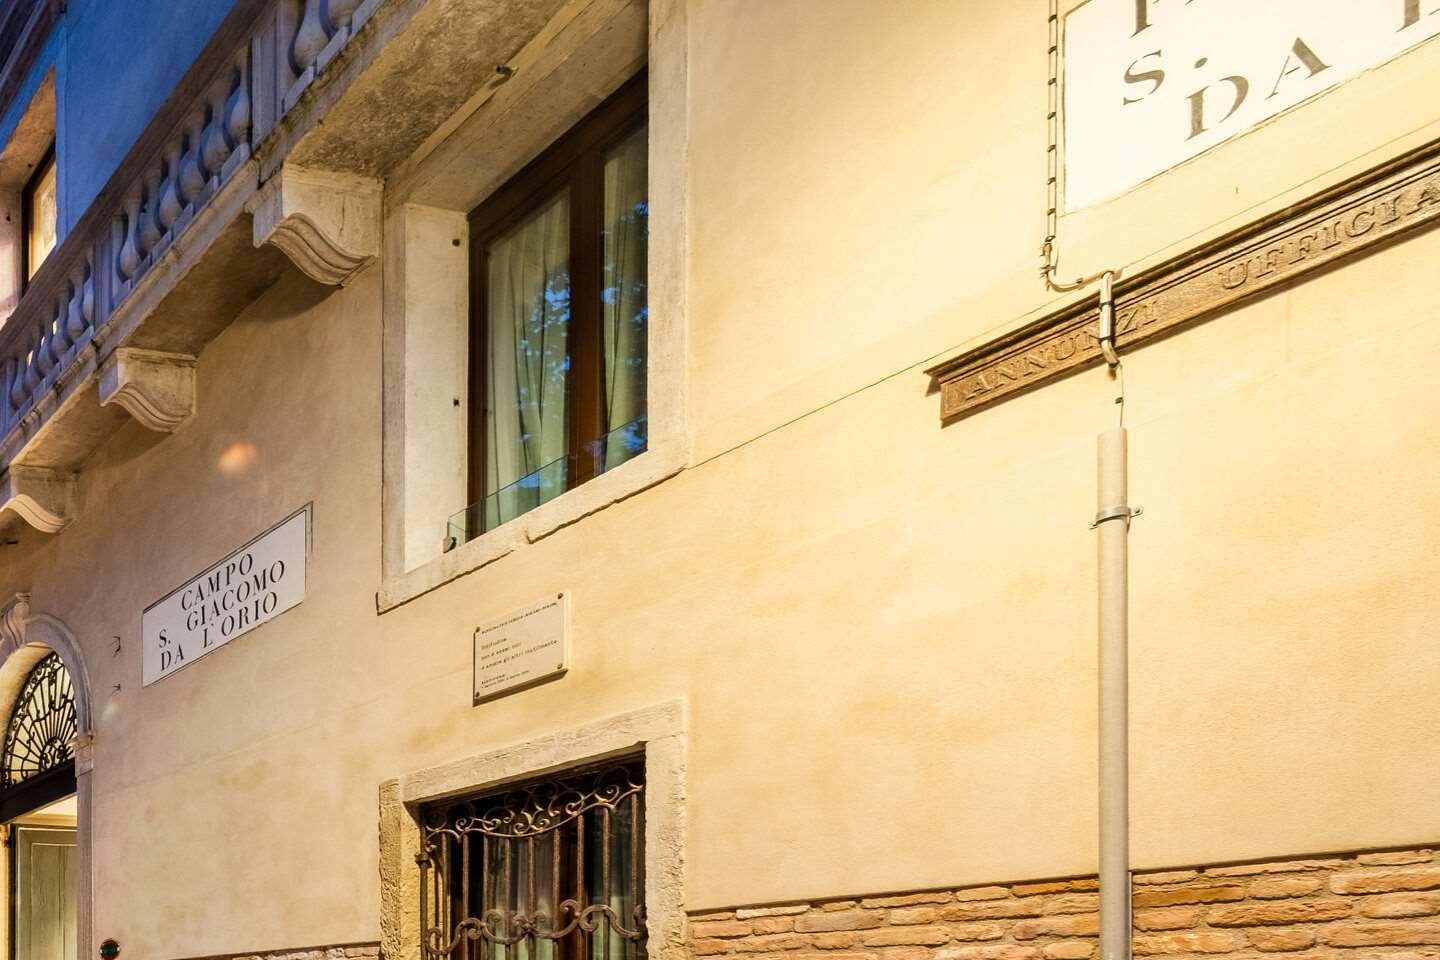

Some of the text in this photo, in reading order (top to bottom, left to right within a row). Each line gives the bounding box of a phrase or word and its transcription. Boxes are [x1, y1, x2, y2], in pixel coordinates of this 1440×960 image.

[1184, 36, 1333, 142] DA
[158, 560, 286, 648] S. GIACOMO
[181, 553, 254, 611] CAMPO
[160, 644, 185, 671] DA
